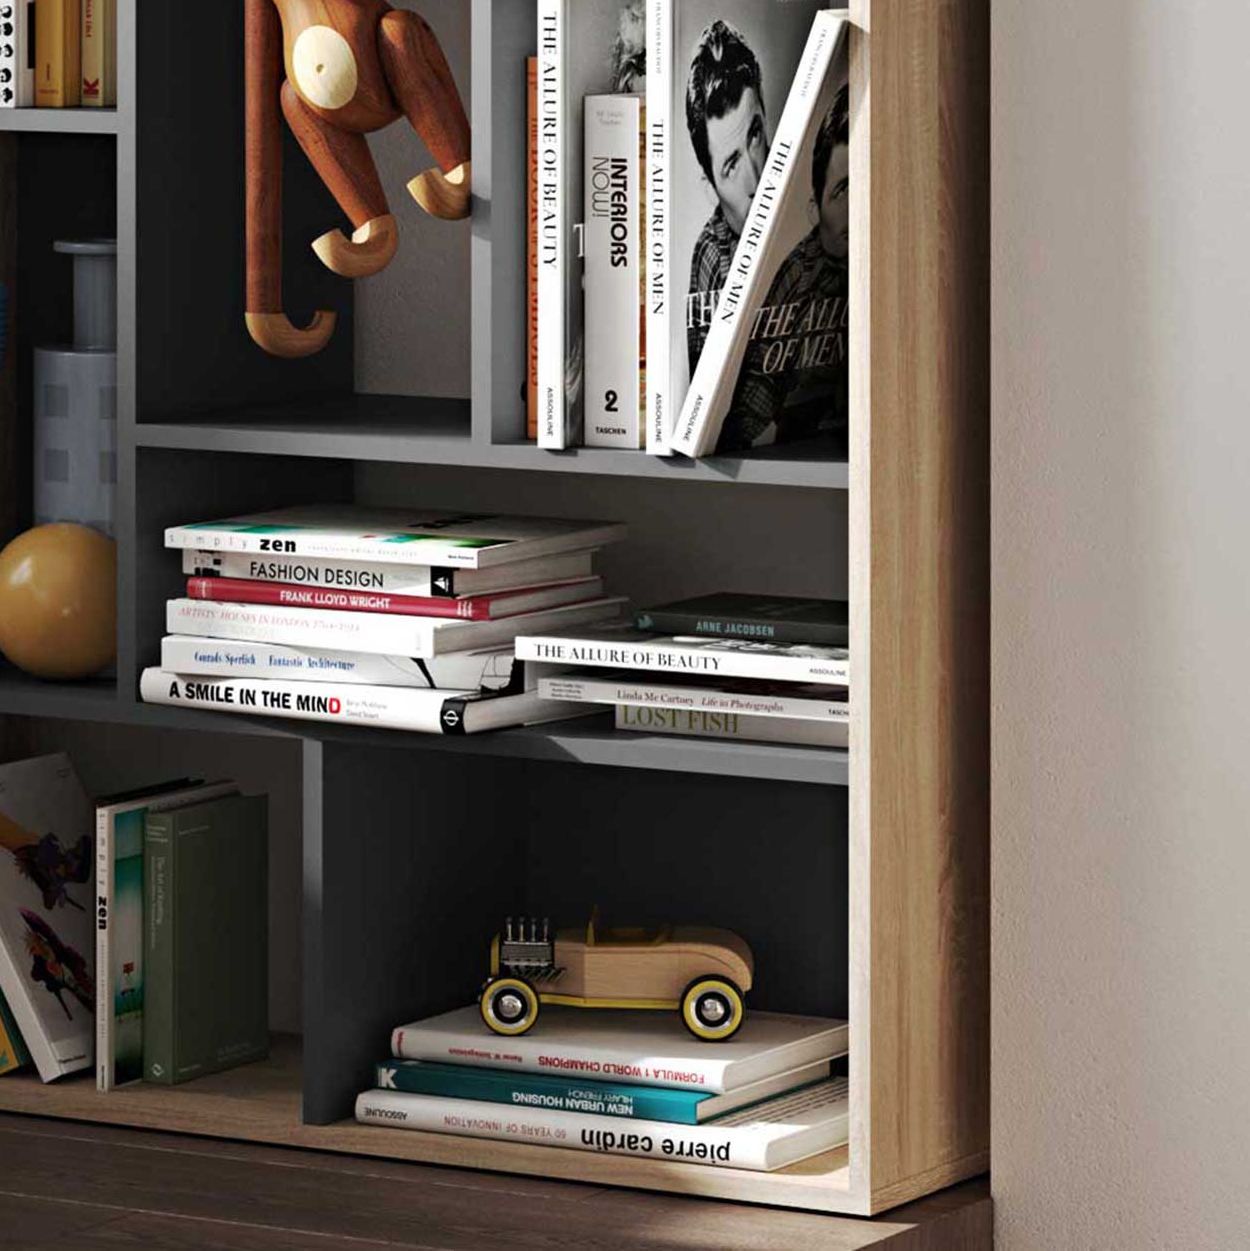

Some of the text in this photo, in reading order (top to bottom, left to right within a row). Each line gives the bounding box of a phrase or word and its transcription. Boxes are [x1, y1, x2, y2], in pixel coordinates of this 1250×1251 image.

[83, 78, 99, 96] K
[543, 12, 558, 269] THE ALLURE OF BEAUTY
[592, 156, 610, 218] NOW!
[611, 158, 628, 268] INTERIORS
[652, 119, 665, 316] THE ALLURE OF MEN
[721, 140, 793, 324] THE ALLURE OF MEN
[686, 288, 723, 329] TH
[750, 303, 801, 341] THE
[762, 333, 847, 375] OF MEN
[604, 389, 618, 412] 2
[595, 426, 627, 435] TASCHEN
[169, 535, 247, 549] simply
[260, 538, 297, 552] zen
[250, 561, 319, 582] FASHION
[325, 568, 384, 588] DESIGN
[280, 590, 391, 610] FRANK LLOYD WRIGHT
[696, 621, 775, 637] ARNE JACOBSEN
[269, 655, 303, 667] Fantastic
[534, 643, 721, 671] THE ALLURE OF BEAUTY
[169, 681, 181, 699] A
[185, 682, 235, 705] SMILE
[239, 688, 256, 706] IN
[262, 690, 291, 709] THE
[296, 694, 341, 715] MIND
[617, 690, 643, 702] Linda
[701, 696, 719, 707] Life
[730, 699, 784, 713] Photographs
[622, 704, 739, 734] LOST FISH
[98, 896, 107, 930] zen
[379, 1068, 399, 1088] K
[538, 1055, 705, 1085] FORMULA 1 WORLD CHAMPIONS
[512, 1092, 634, 1116] NEW URBAN HOUSING
[568, 1090, 633, 1104] HILARY FRENCH
[364, 1106, 408, 1121] ASSOULINE
[444, 1116, 503, 1133] INNOVATION
[506, 1122, 518, 1134] OF
[521, 1123, 552, 1138] YEARS
[581, 1127, 654, 1152] cardin
[662, 1138, 731, 1164] pierre
